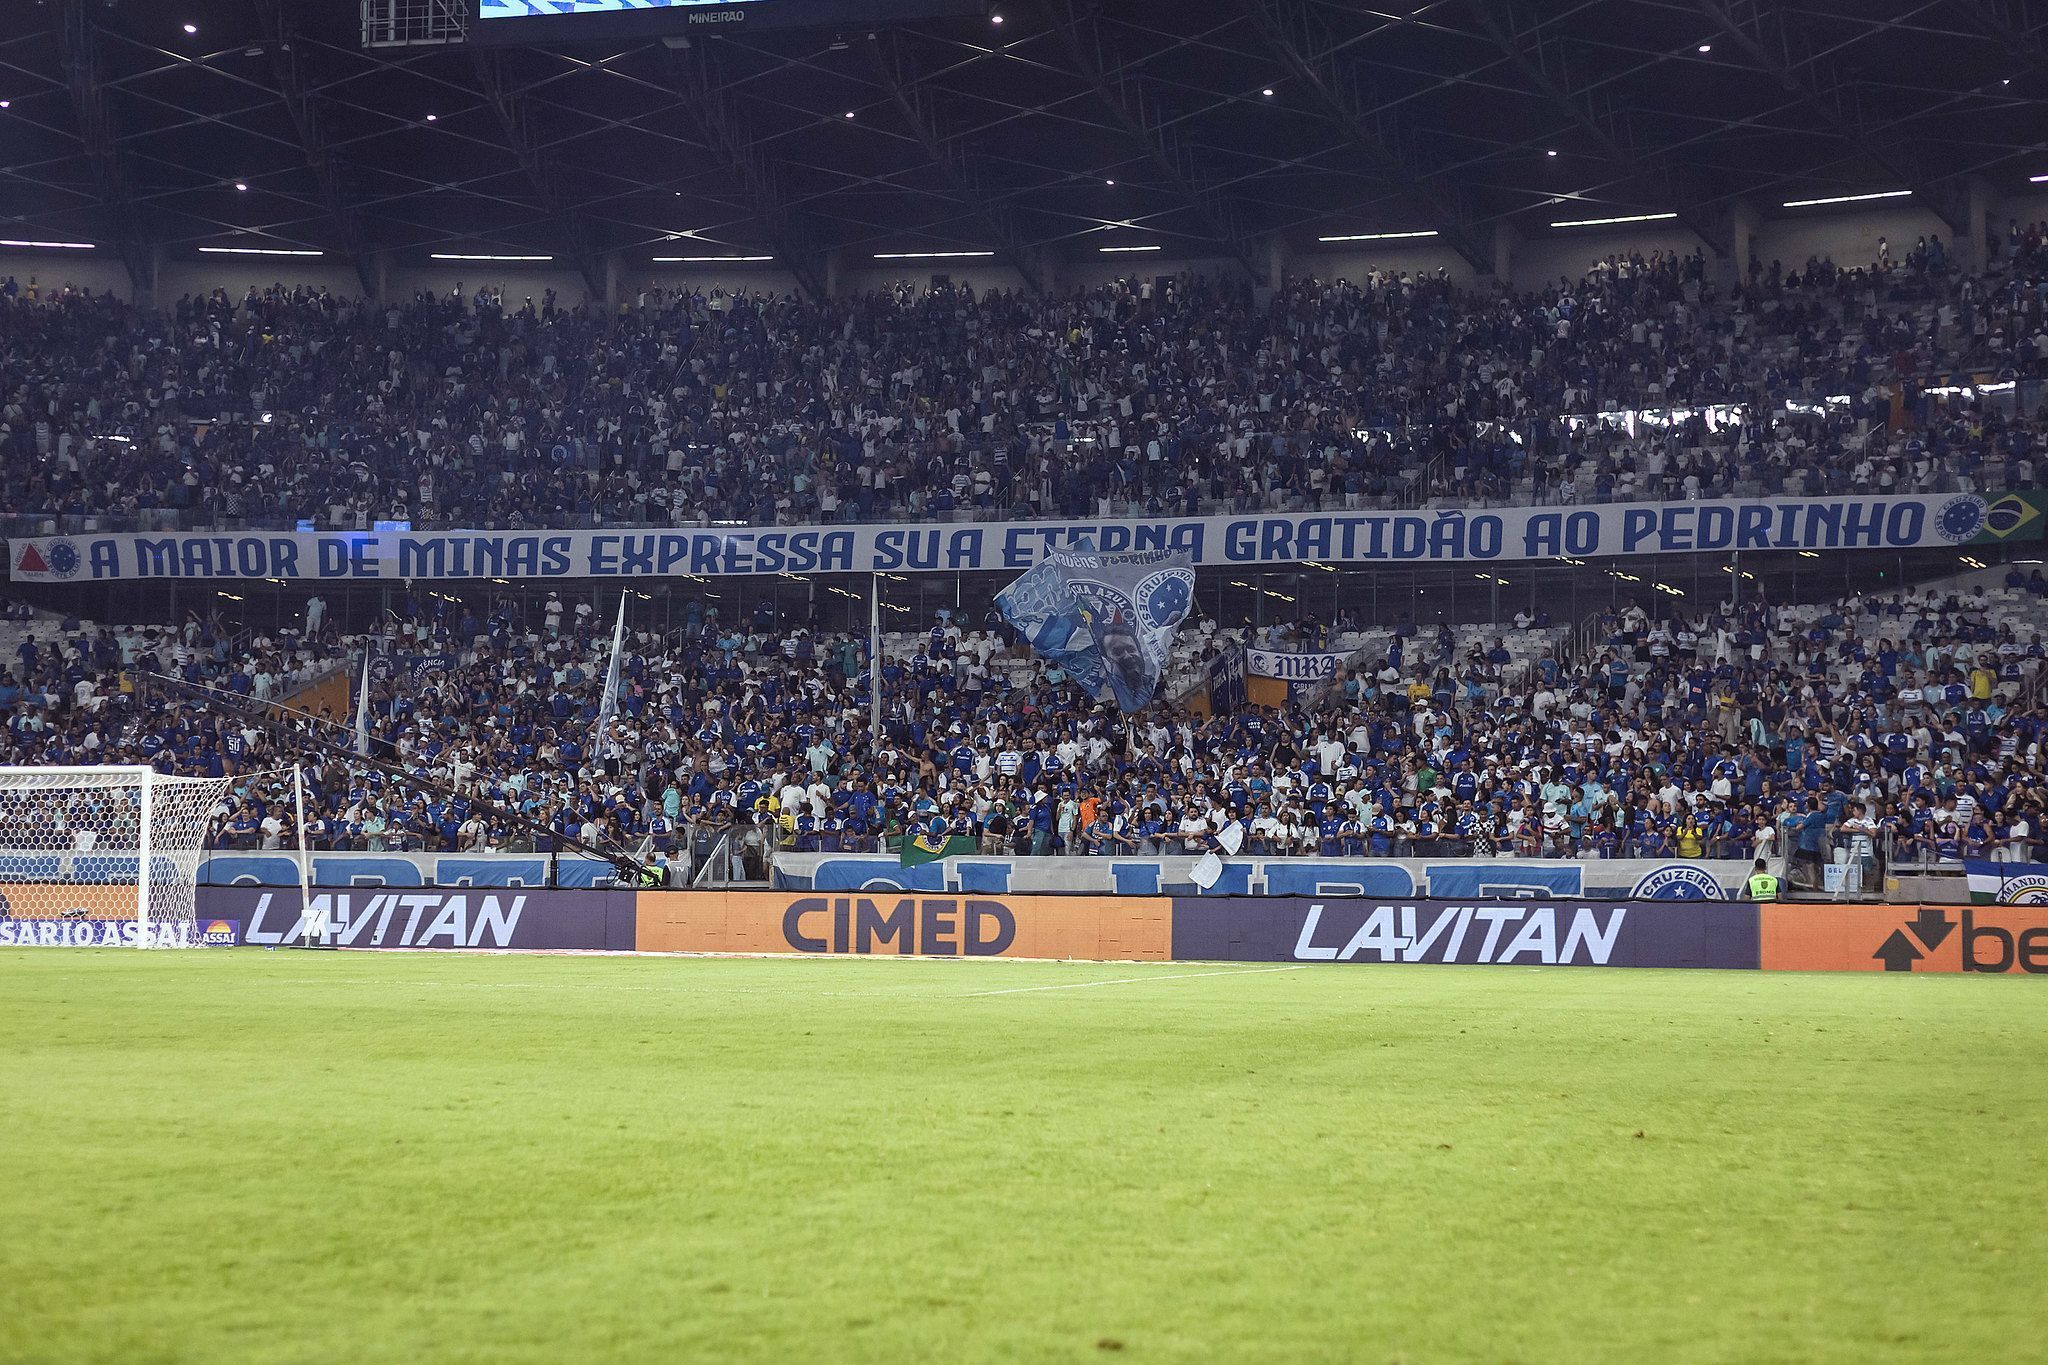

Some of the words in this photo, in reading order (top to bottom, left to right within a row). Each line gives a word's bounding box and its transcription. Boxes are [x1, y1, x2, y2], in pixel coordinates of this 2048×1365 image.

[89, 539, 120, 578] A
[134, 538, 299, 577] MAIOR
[318, 538, 380, 577] DE
[399, 535, 571, 577] MINAS
[587, 530, 854, 575] EXPRESSA
[873, 529, 983, 570] SUA
[1224, 510, 1503, 561] GRATIDÃO
[1522, 511, 1600, 556] AO
[1623, 502, 1926, 552] PEDRINHO
[1643, 871, 1716, 896] CRUZEIRO
[245, 892, 527, 948] LAVITAN
[782, 898, 1016, 956] CIMED
[1294, 904, 1627, 965] LAVITAN
[1962, 909, 2048, 974] be
